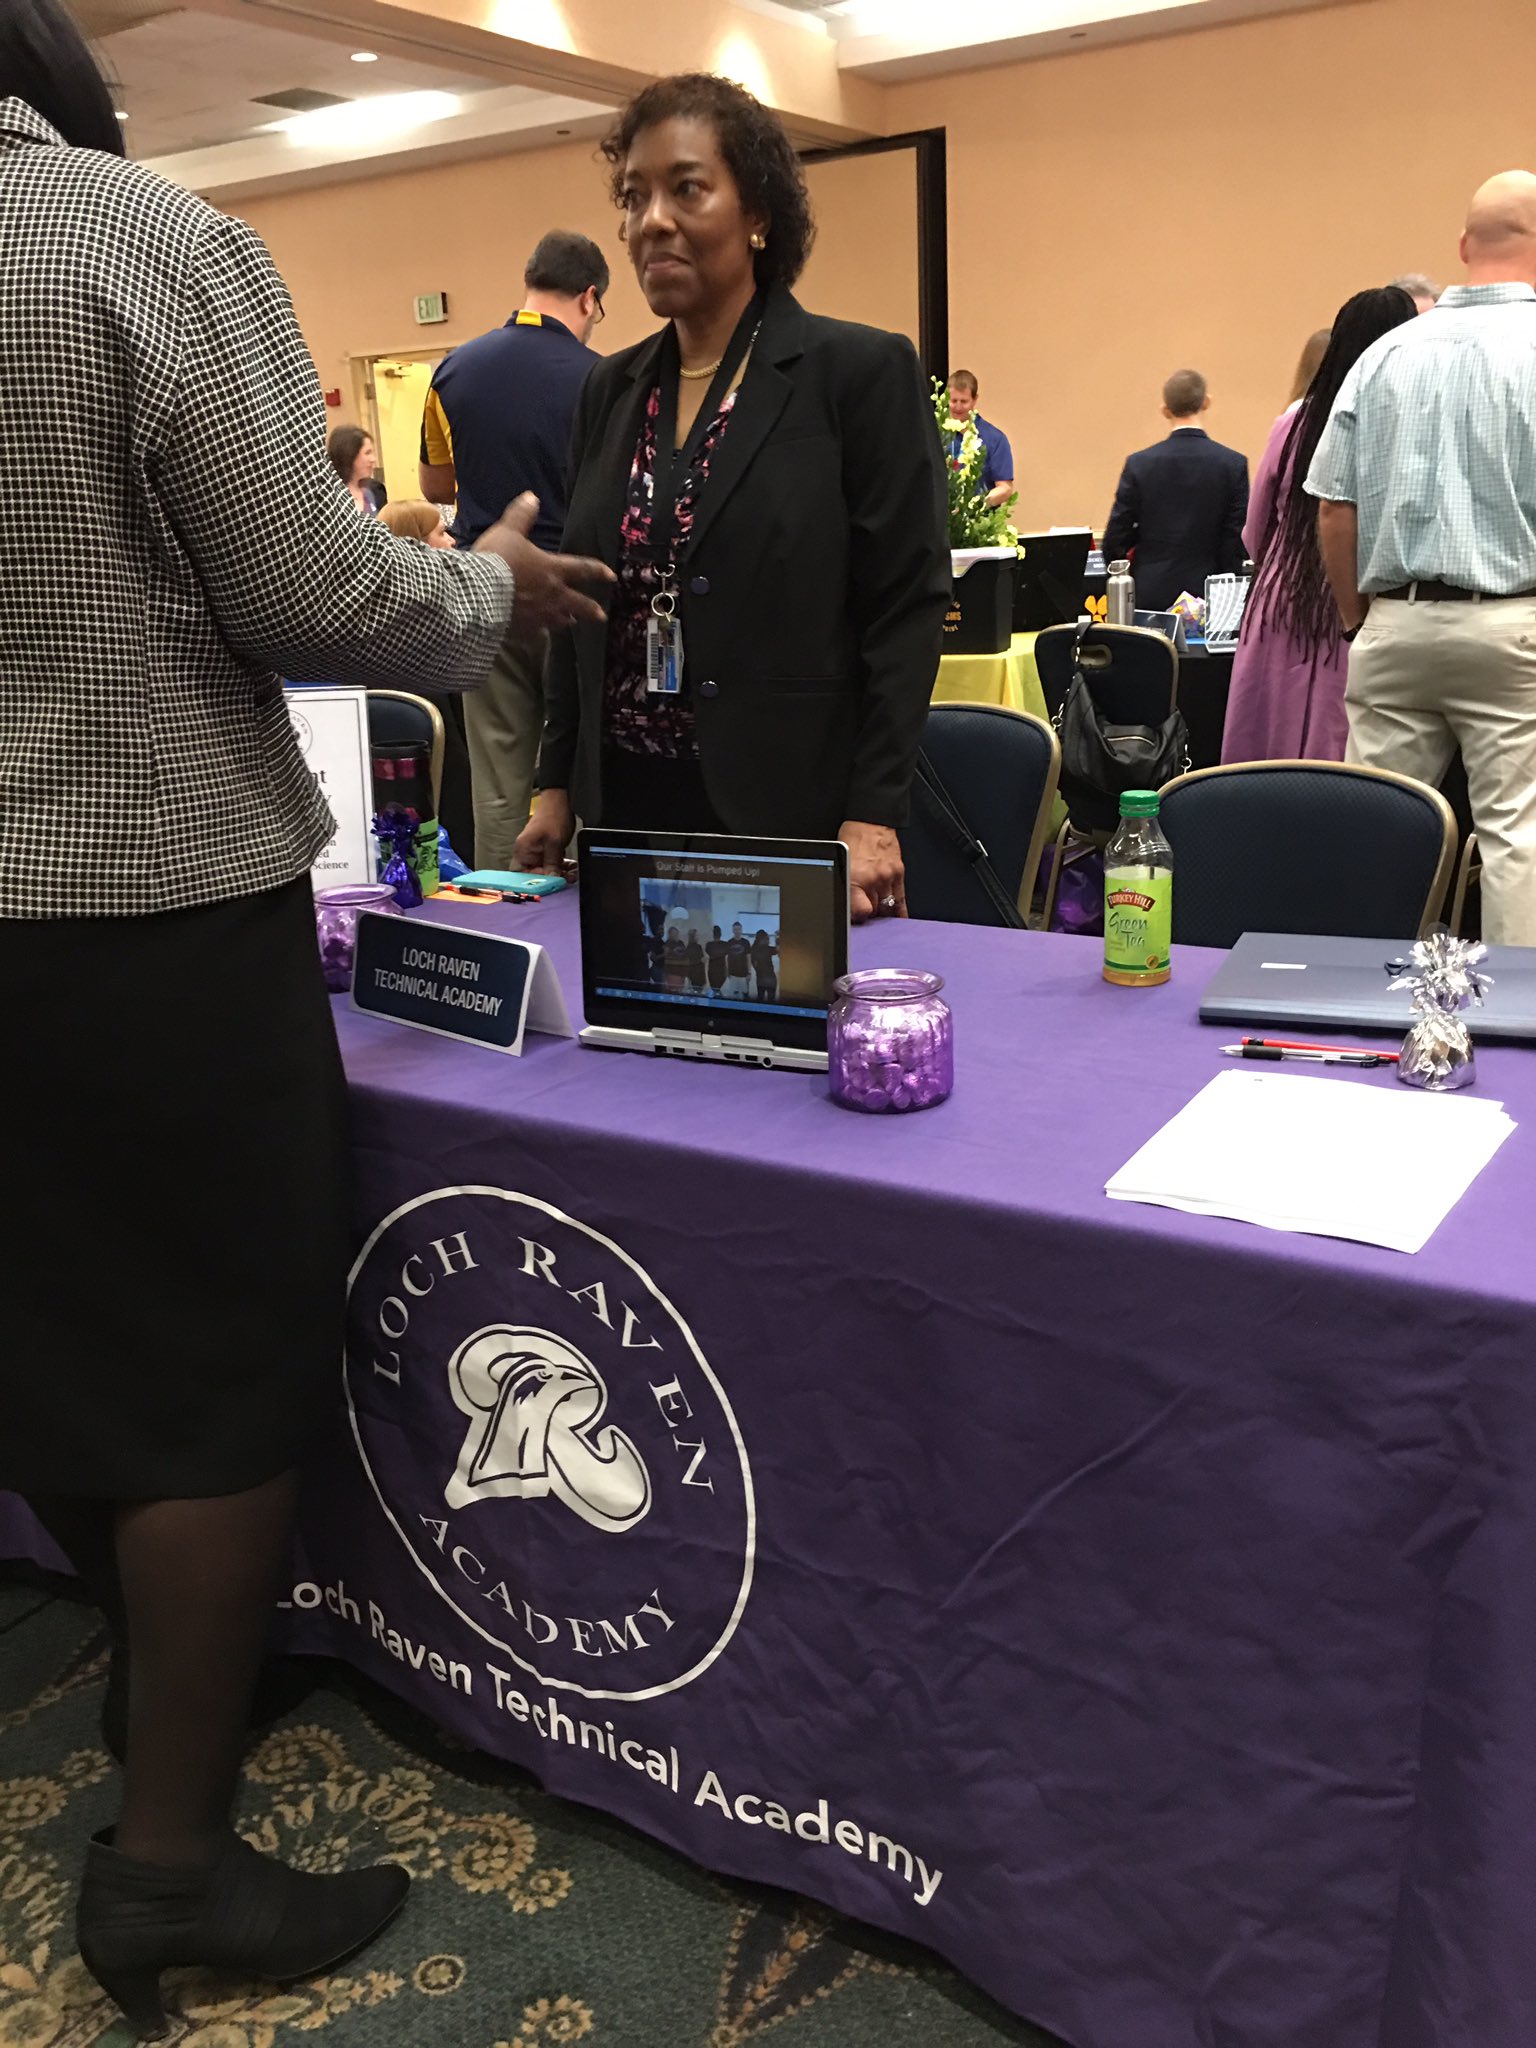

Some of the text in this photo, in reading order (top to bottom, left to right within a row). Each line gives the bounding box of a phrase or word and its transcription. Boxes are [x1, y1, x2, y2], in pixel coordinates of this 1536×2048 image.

[1108, 894, 1151, 909] TURKEY HILL
[1109, 911, 1148, 935] Green
[1120, 930, 1145, 948] Tea
[402, 946, 481, 981] LOCH RAVEN
[374, 968, 503, 1017] TECHNICAL ACADEMY
[373, 1230, 715, 1494] LOCH RAVEN
[418, 1512, 676, 1659] ACADEMY
[368, 1600, 474, 1697] Raven
[485, 1662, 680, 1795] Technical
[693, 1770, 943, 1907] Academy
